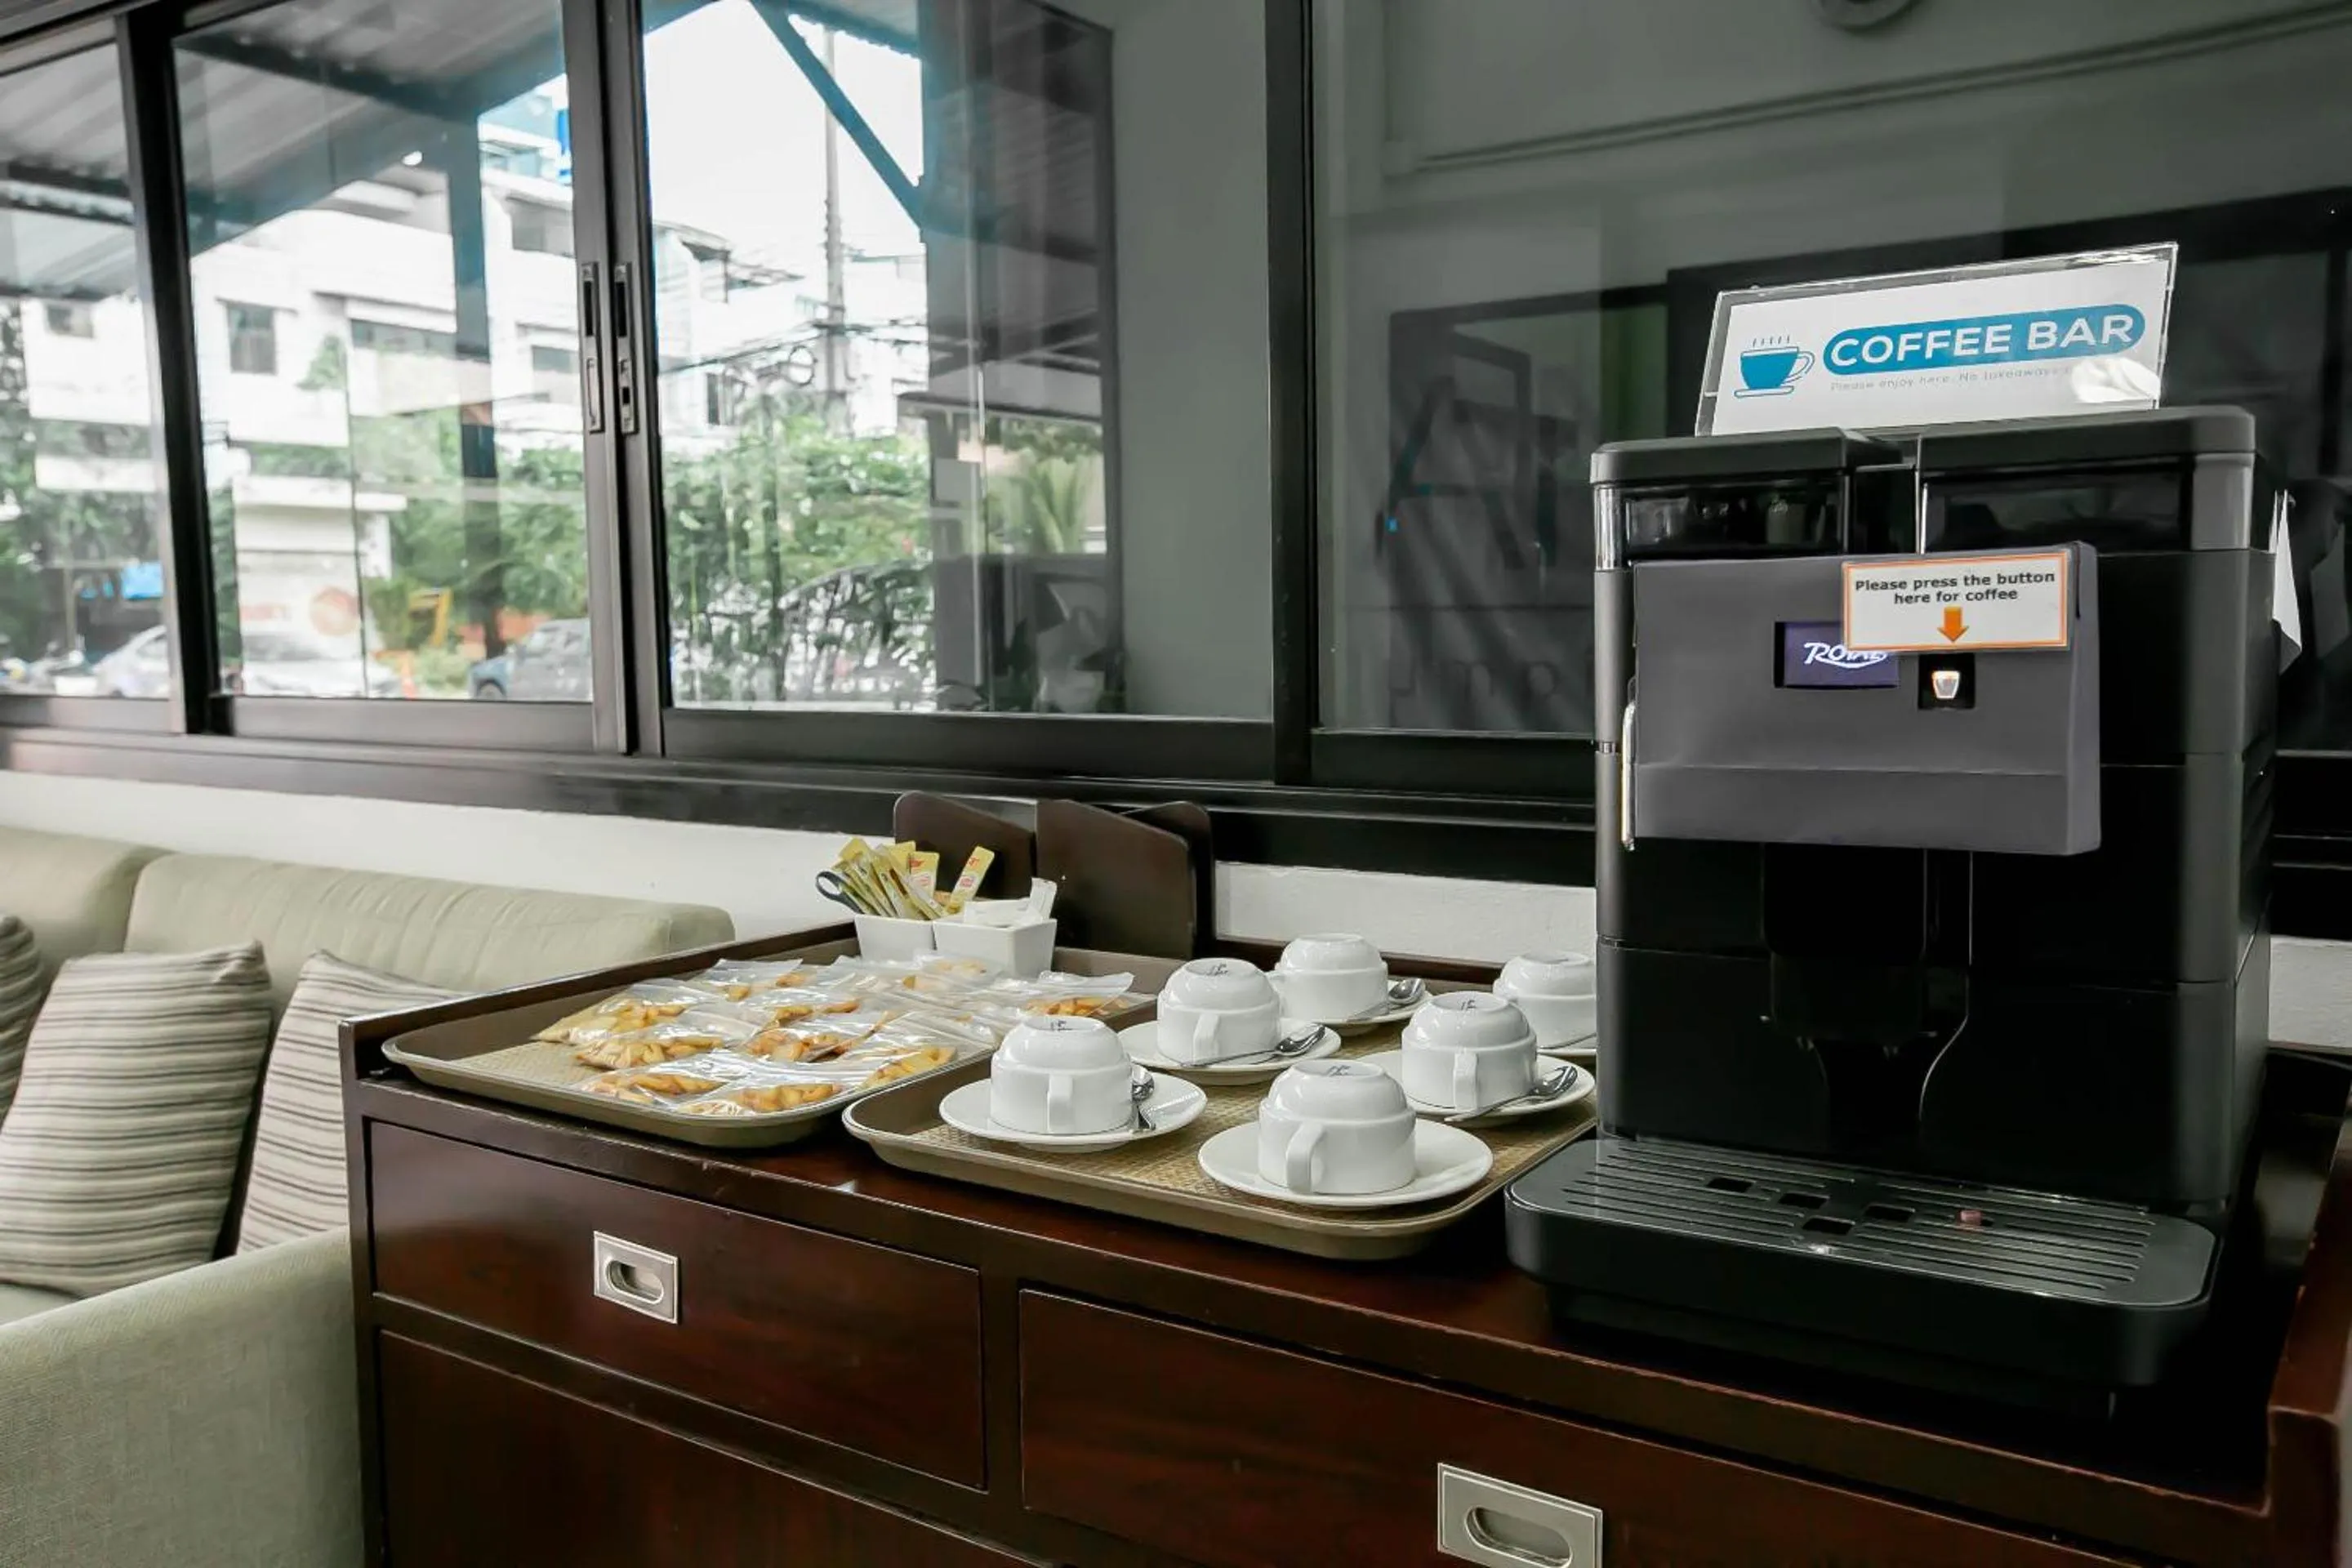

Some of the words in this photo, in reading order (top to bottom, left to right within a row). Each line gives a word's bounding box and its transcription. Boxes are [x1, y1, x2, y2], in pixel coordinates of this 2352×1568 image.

[1830, 323, 2011, 368] COFFEE
[2027, 314, 2133, 350] BAR
[1879, 377, 1913, 390] enjoy
[1959, 372, 1978, 382] No
[1855, 579, 1907, 591] Please
[1913, 577, 1958, 591] press
[1963, 574, 1991, 586] the
[1997, 572, 2055, 586] button
[1894, 593, 1931, 604] here
[1936, 590, 1959, 603] for
[1966, 588, 2018, 602] coffee
